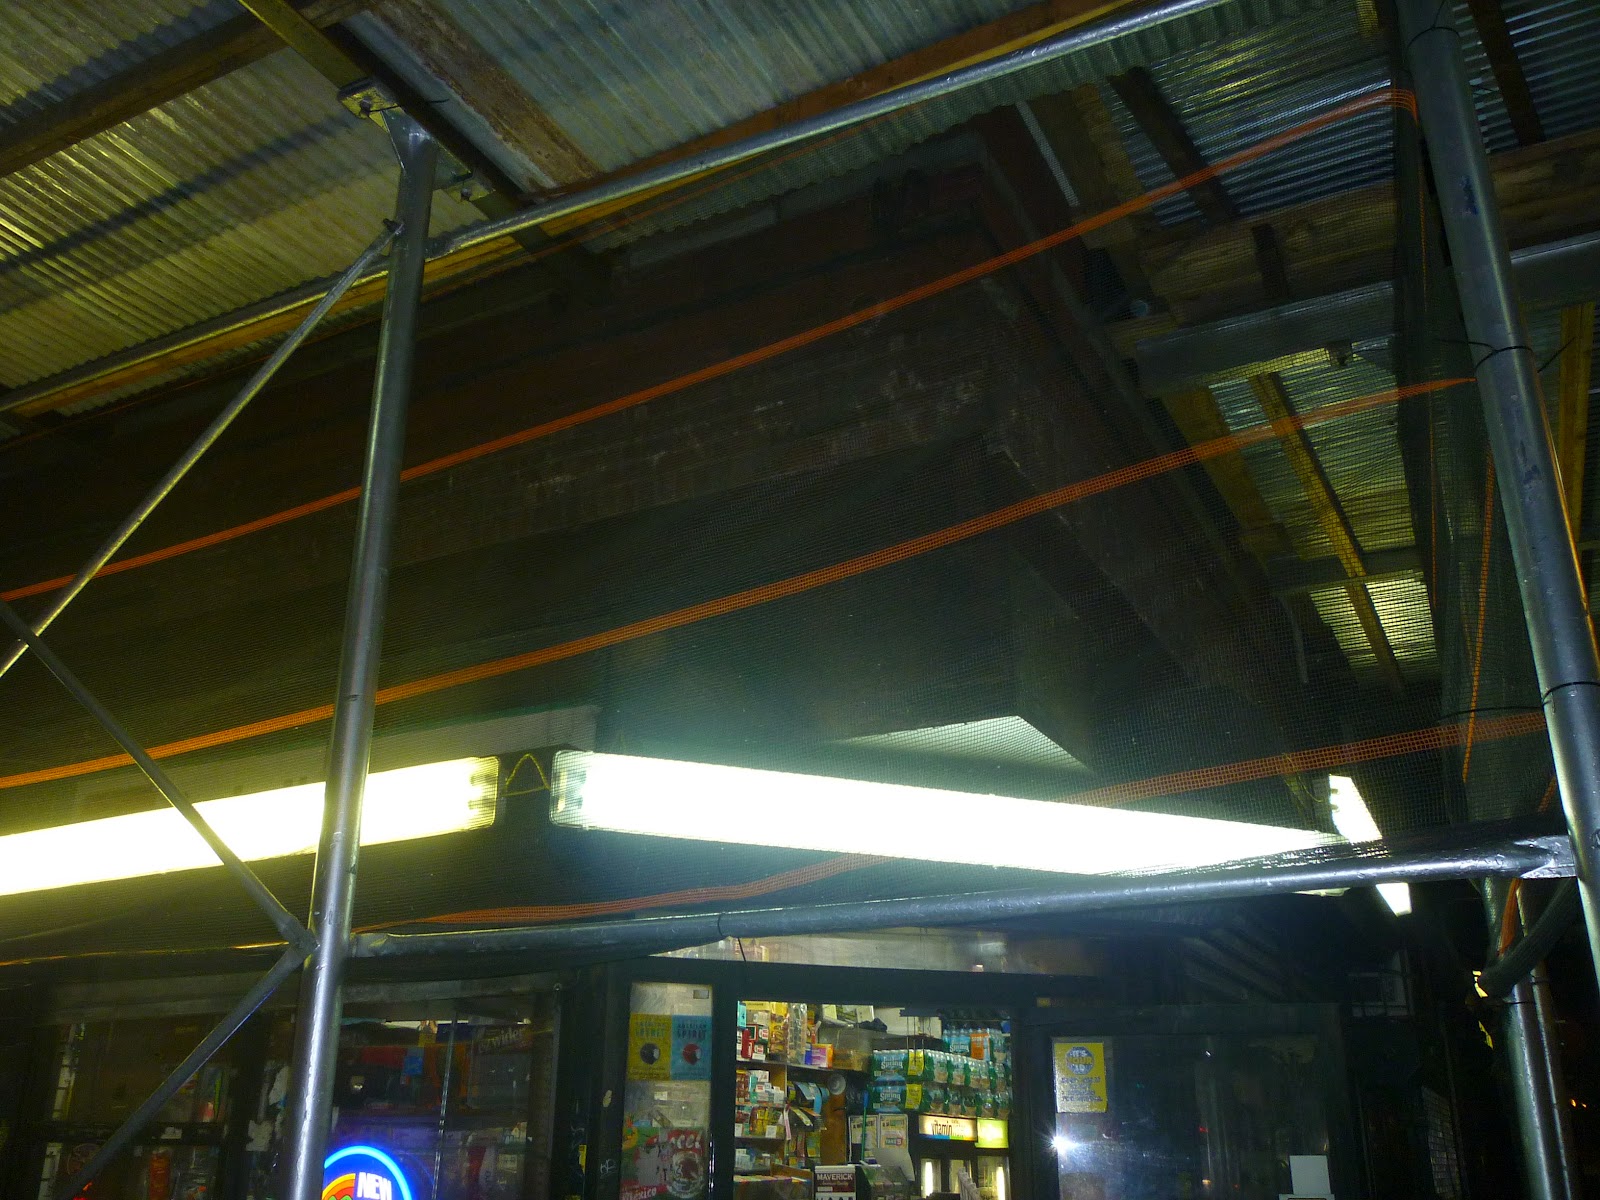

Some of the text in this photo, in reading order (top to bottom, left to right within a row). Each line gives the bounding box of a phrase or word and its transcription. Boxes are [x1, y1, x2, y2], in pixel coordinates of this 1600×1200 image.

[677, 1029, 707, 1040] SPIRIT
[880, 1060, 903, 1070] Spring
[879, 1092, 902, 1102] Spring
[931, 1119, 953, 1136] vitamin
[816, 1173, 853, 1181] MAVERICK
[356, 1171, 393, 1200] NEW
